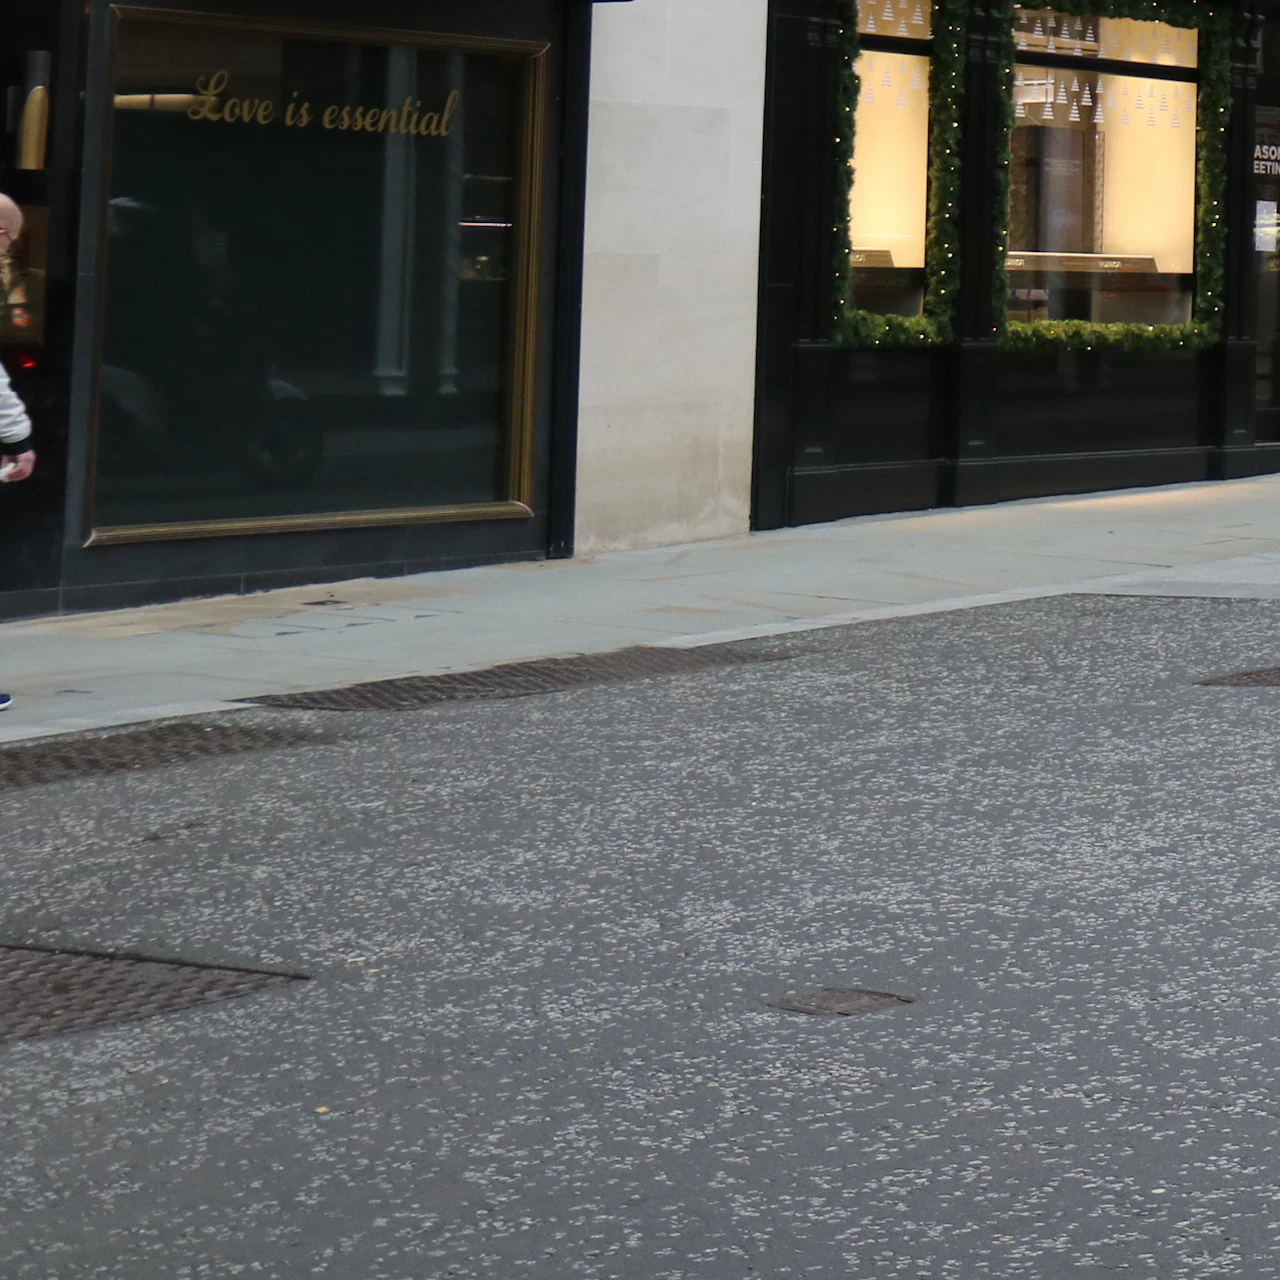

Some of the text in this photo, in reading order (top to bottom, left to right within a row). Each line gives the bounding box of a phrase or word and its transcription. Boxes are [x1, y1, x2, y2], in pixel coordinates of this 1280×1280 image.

[187, 70, 460, 137] Love is essential
